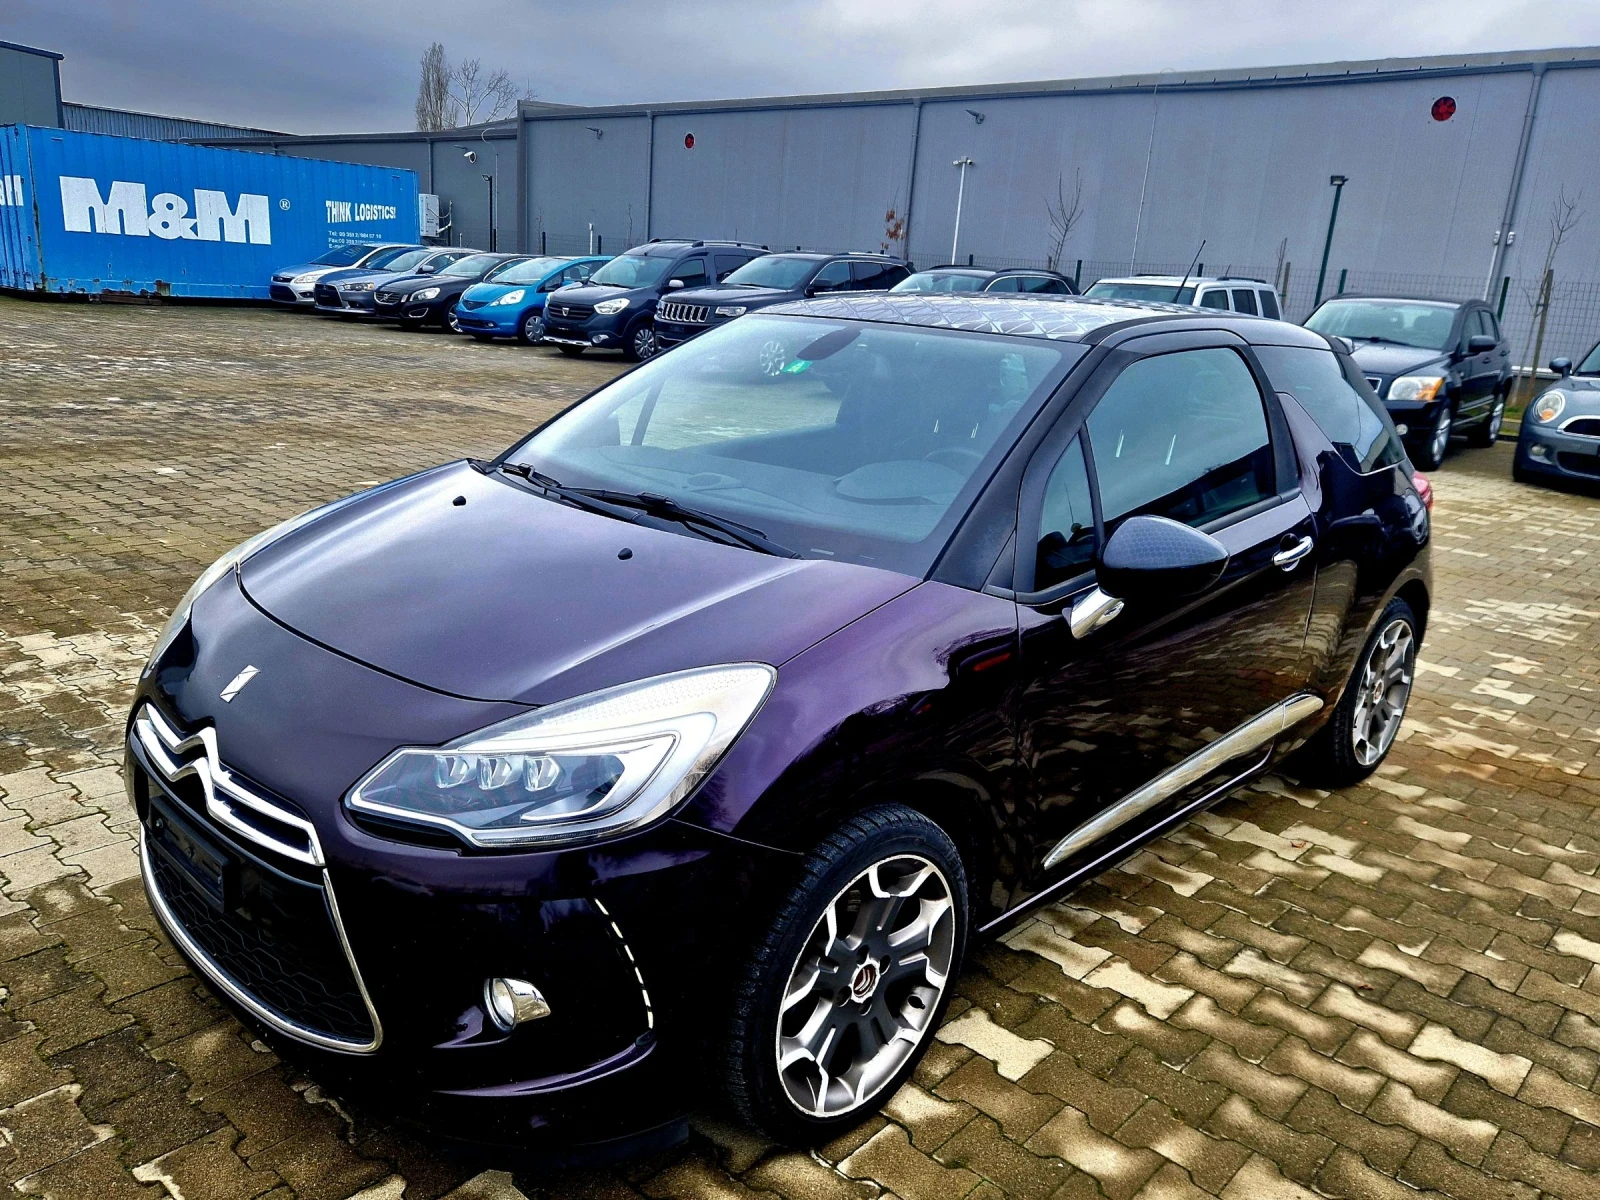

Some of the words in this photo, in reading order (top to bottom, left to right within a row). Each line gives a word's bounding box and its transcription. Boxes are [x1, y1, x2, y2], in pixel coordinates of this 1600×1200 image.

[59, 175, 272, 245] M&M
[326, 200, 352, 223] THINK
[354, 203, 396, 221] LOGISTICS!
